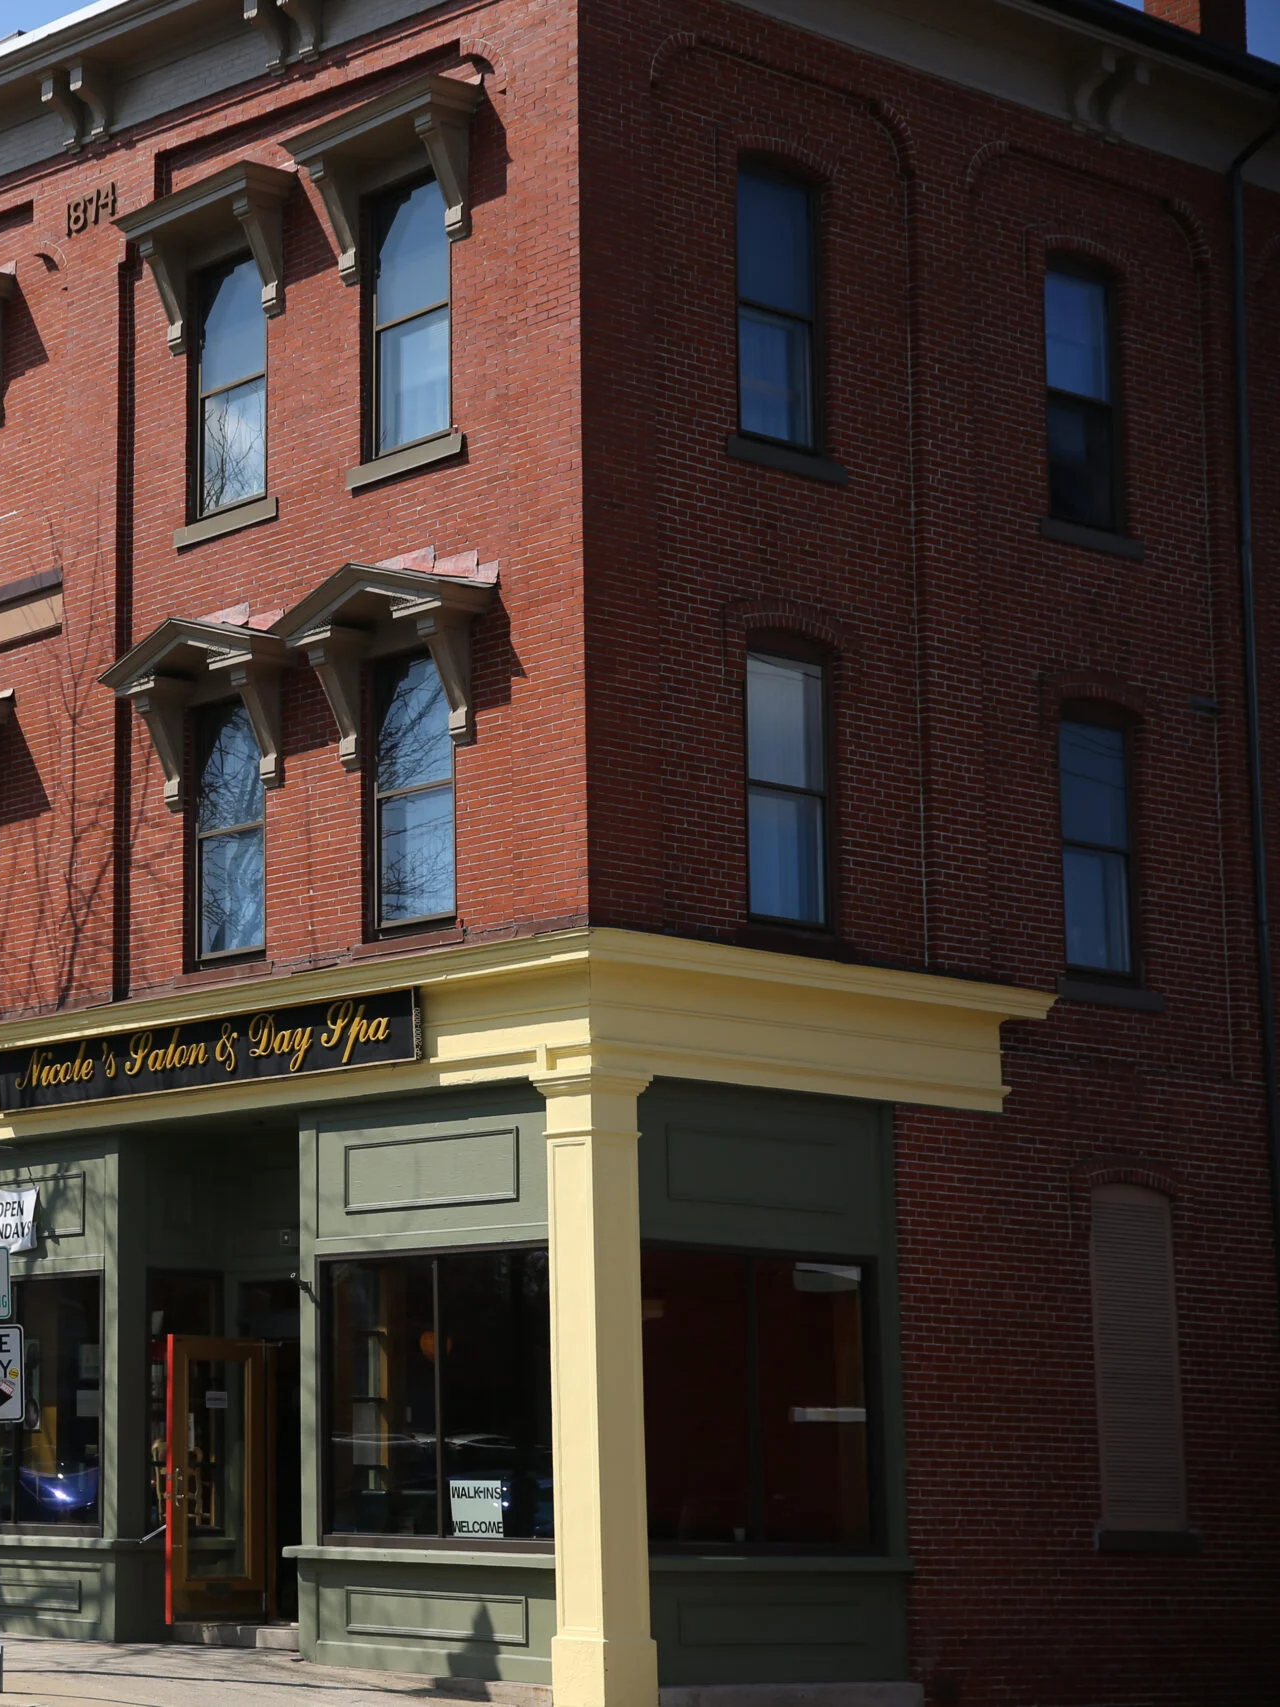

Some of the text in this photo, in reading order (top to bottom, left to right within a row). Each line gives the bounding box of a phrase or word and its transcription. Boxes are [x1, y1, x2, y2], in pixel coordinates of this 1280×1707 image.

[65, 180, 117, 238] 1874
[14, 1000, 391, 1091] Nicole's Salon & Day Spa
[451, 1486, 502, 1500] WALK-INS
[452, 1520, 504, 1535] WELCOME
